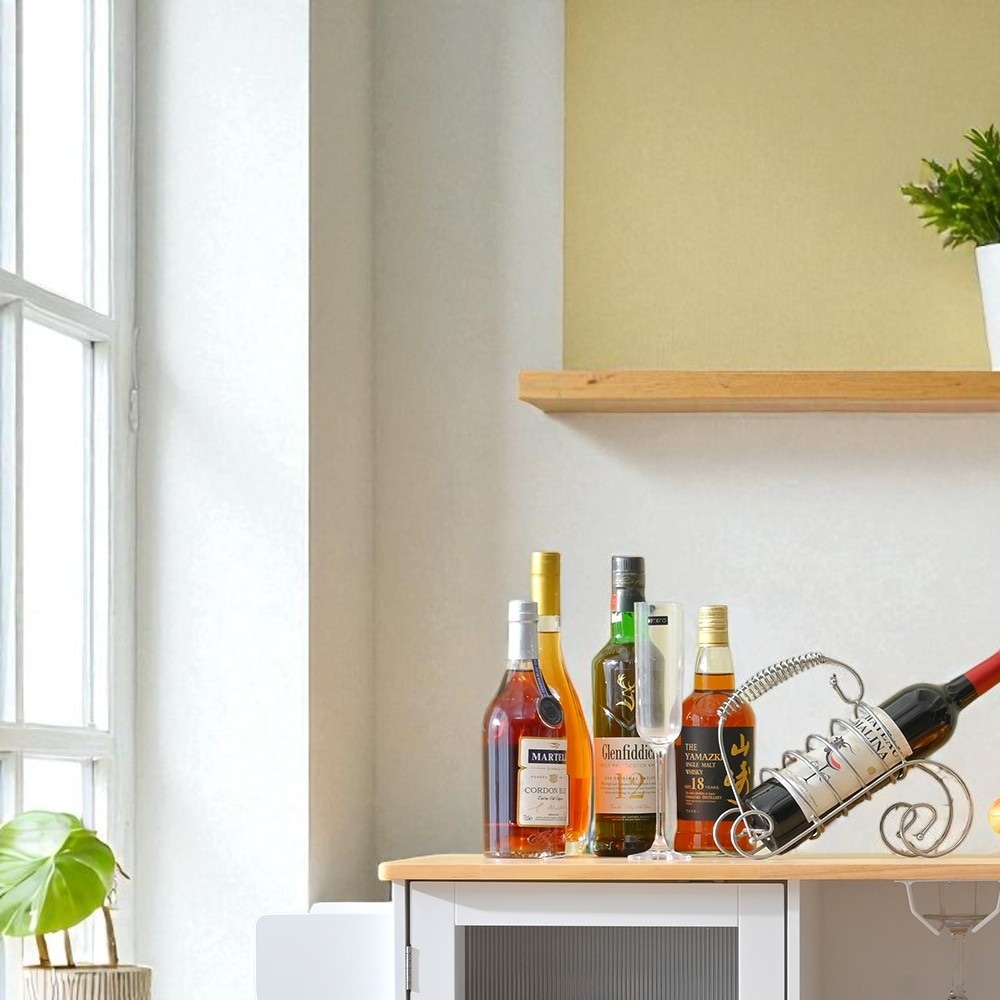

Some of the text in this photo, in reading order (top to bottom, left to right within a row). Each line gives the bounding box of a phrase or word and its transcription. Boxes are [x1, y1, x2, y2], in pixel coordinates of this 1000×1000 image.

[602, 744, 656, 760] Glenfiddic
[685, 743, 698, 751] THE
[524, 786, 558, 794] CORDON
[615, 772, 646, 799] 12
[691, 777, 705, 790] 18
